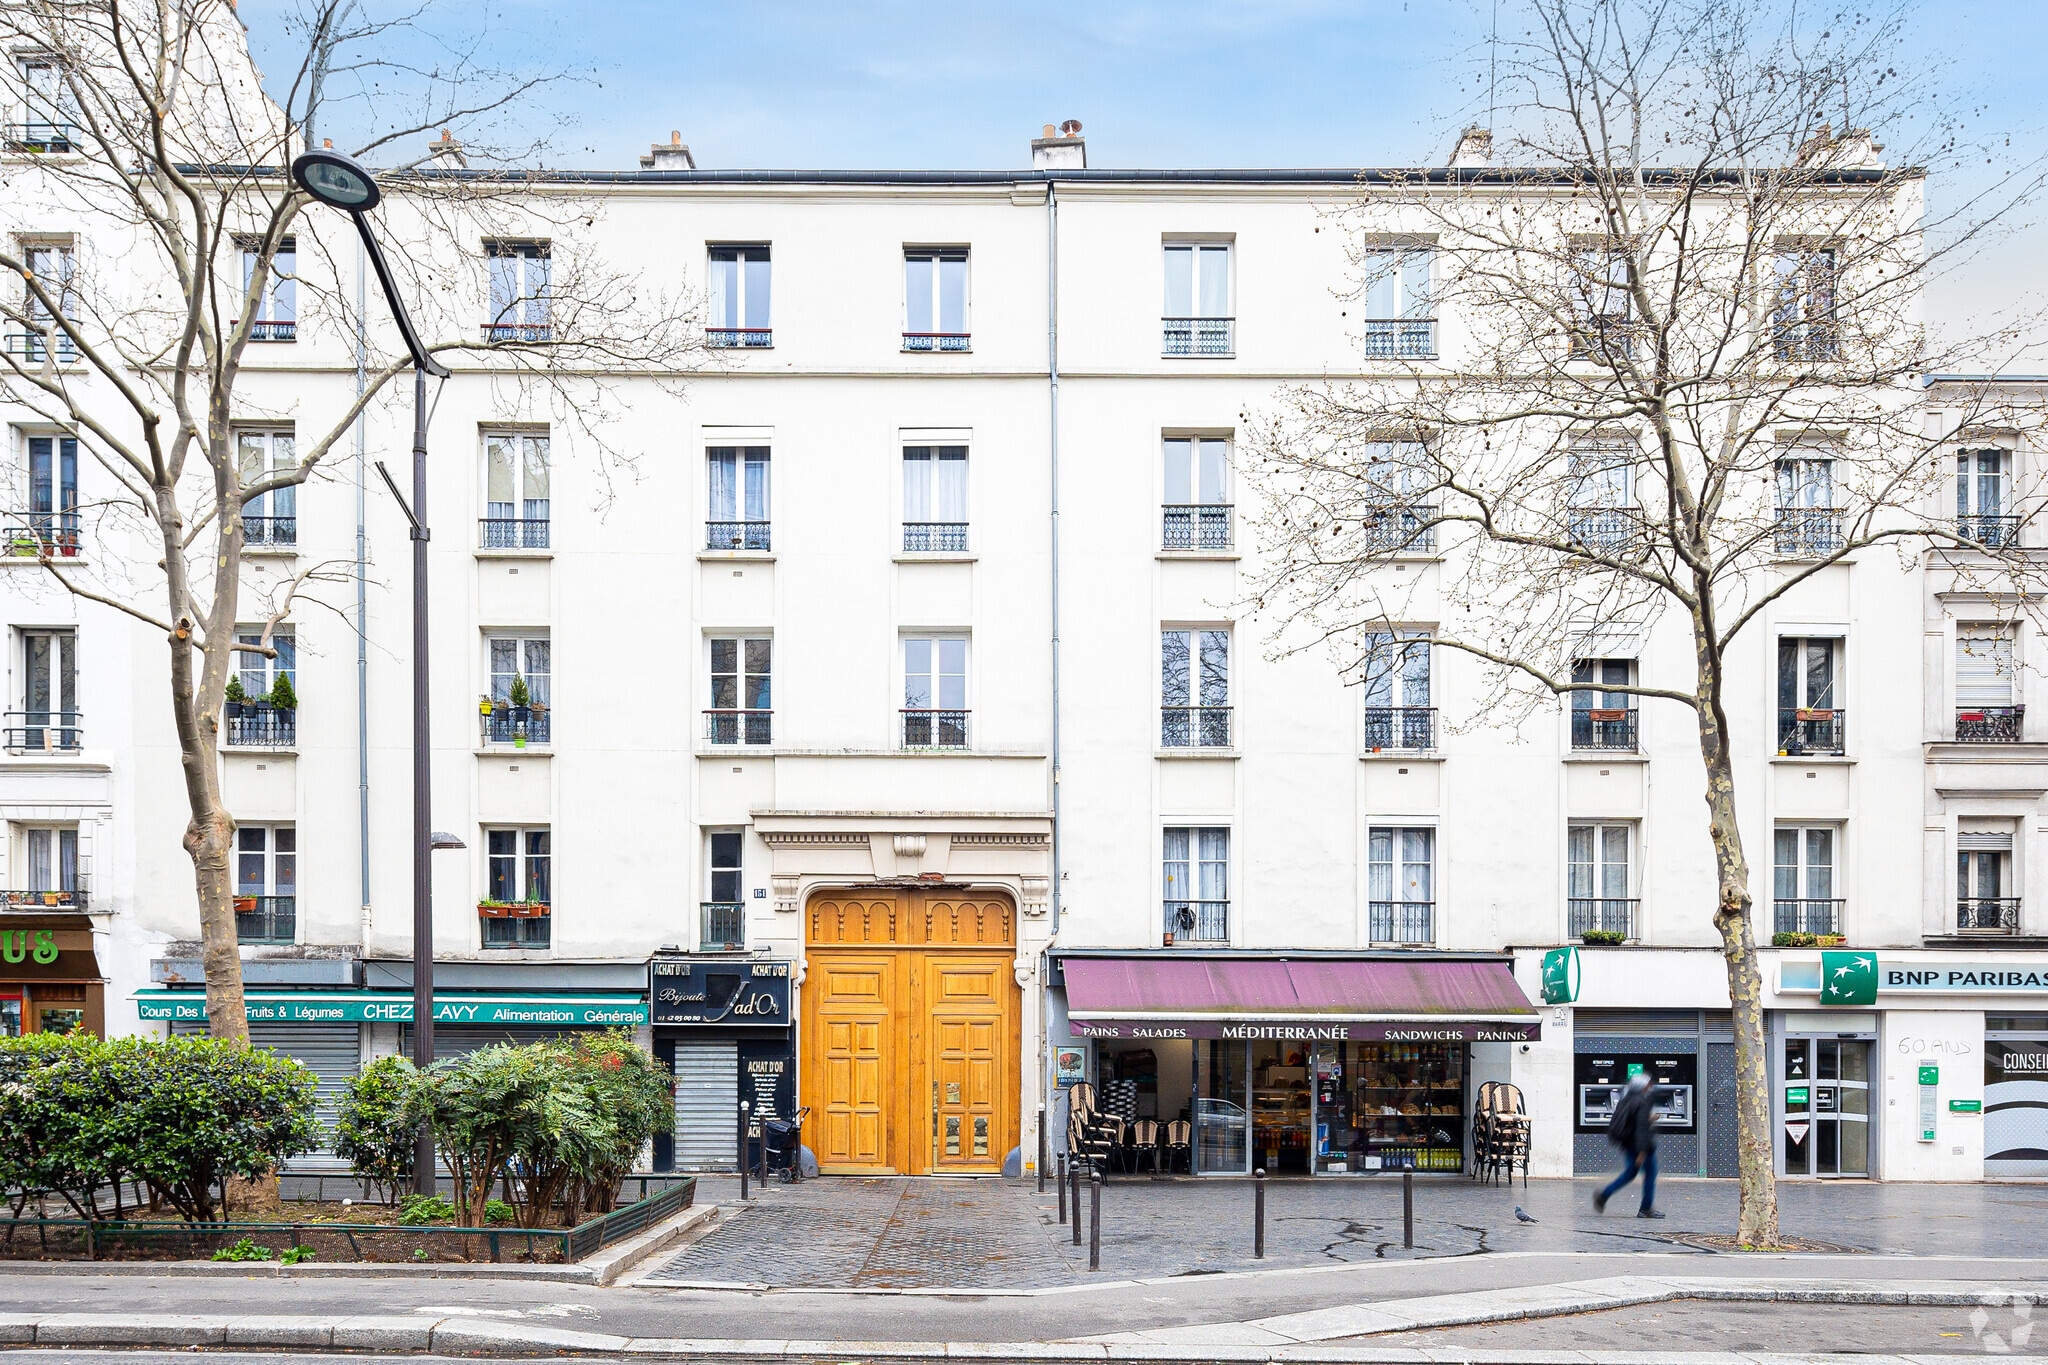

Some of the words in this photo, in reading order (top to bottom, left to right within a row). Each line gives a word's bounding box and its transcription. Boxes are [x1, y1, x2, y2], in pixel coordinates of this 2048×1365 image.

[654, 964, 675, 976] ACHAT
[751, 965, 772, 977] ACHAT
[772, 965, 788, 977] D'OR
[1888, 971, 1940, 985] BNP
[140, 1006, 172, 1018] Cours
[176, 1006, 199, 1018] Des
[244, 1006, 274, 1018] Fruits
[278, 1006, 287, 1018] &
[295, 1006, 344, 1021] Légumes
[363, 1004, 413, 1019] CHEZ
[492, 1009, 574, 1021] Alimentation
[583, 1010, 644, 1023] Générale
[1083, 1027, 1119, 1037] PAINS
[1132, 1027, 1187, 1038] SALADES
[1222, 1024, 1349, 1039] MÉDITERRANÉE
[1384, 1030, 1463, 1040] SANDWICHS
[1477, 1031, 1528, 1041] PANINIS
[1899, 1037, 1925, 1054] 60
[1931, 1039, 1971, 1055] ANS
[748, 1061, 768, 1072] ACHAT
[769, 1061, 784, 1072] D'OR
[2004, 1053, 2048, 1069] CONSEI
[748, 1126, 760, 1138] ACH
